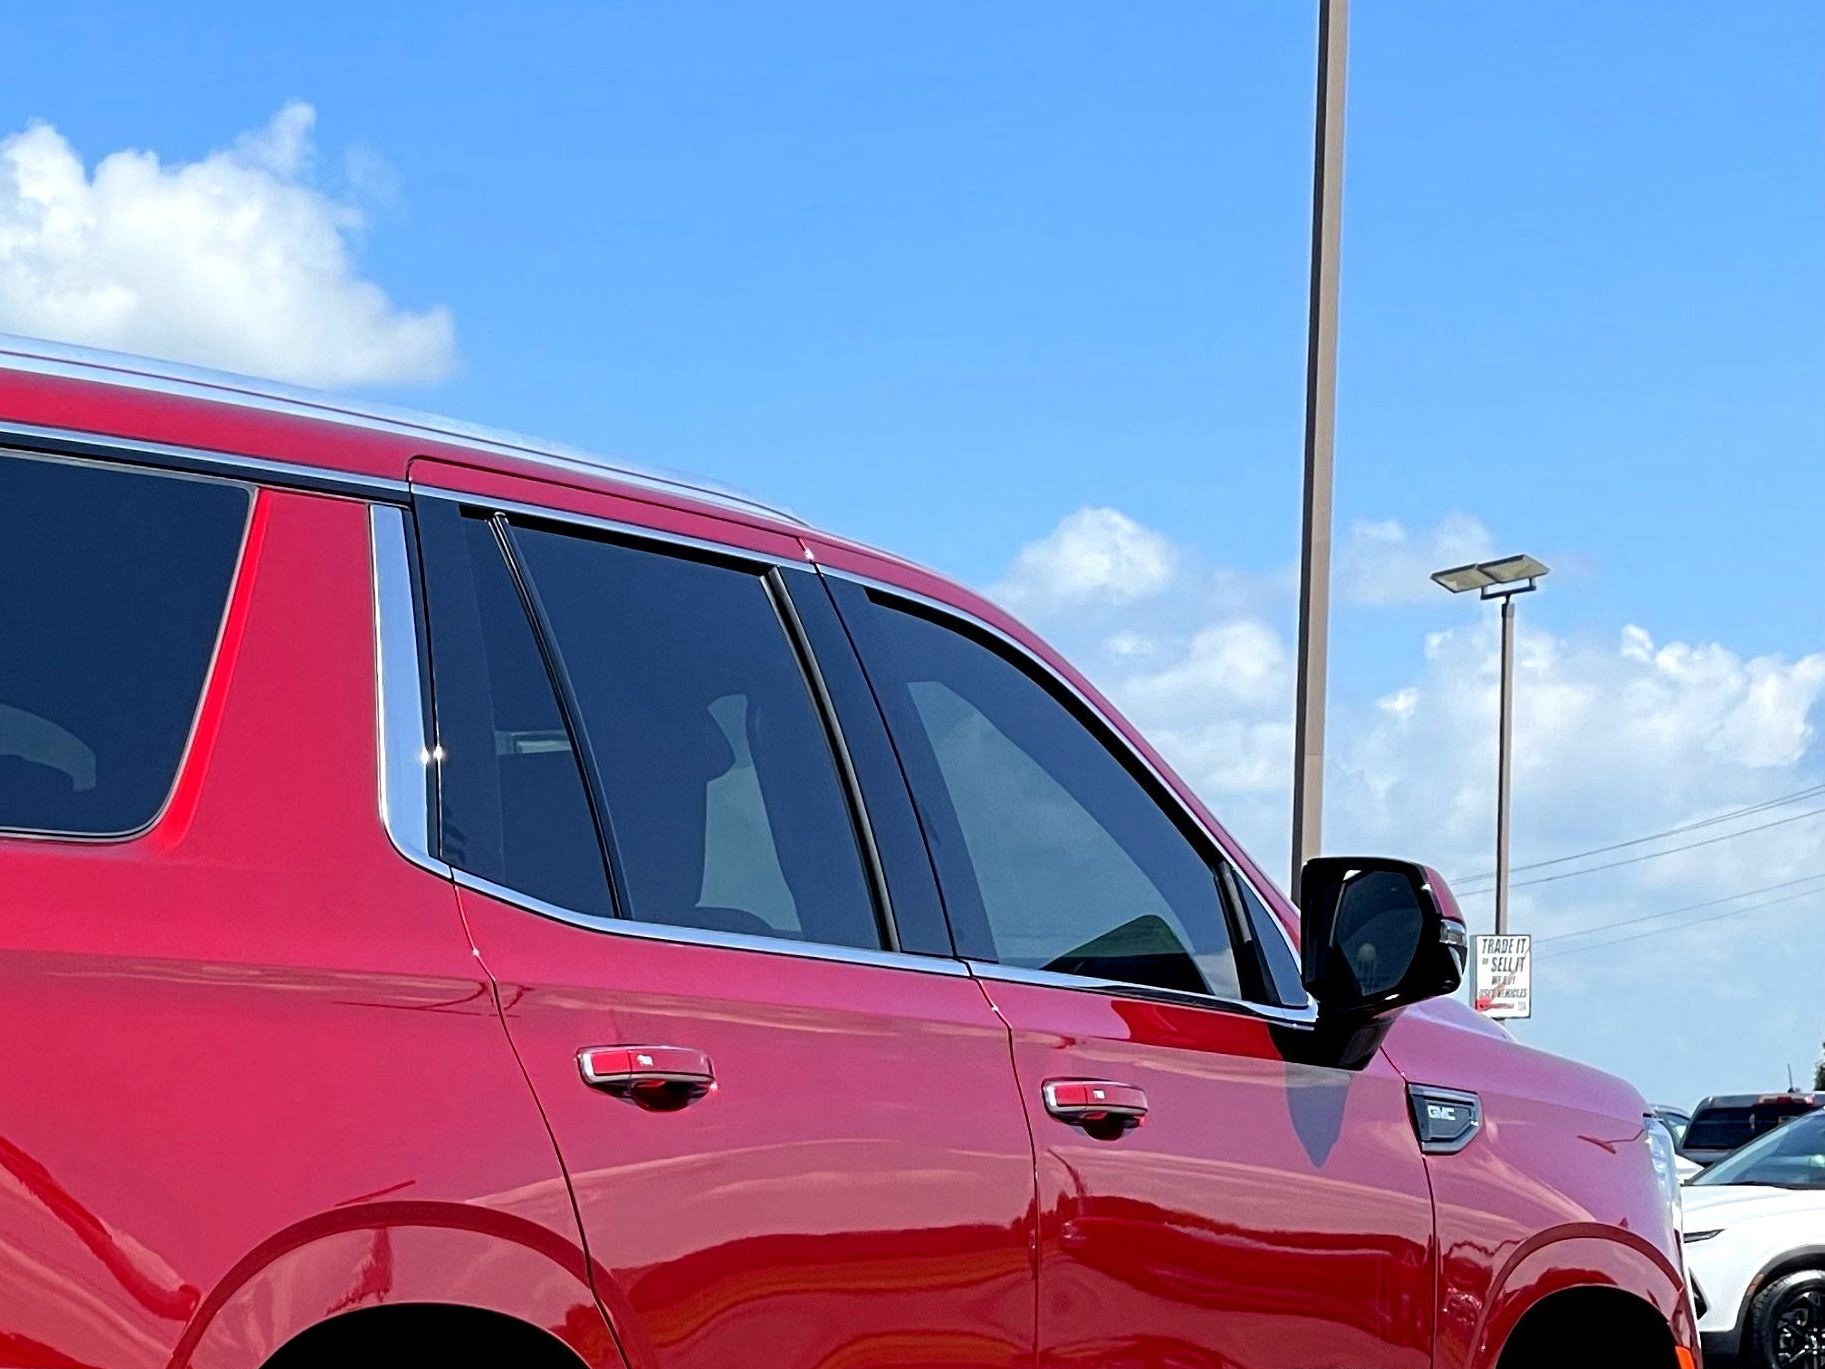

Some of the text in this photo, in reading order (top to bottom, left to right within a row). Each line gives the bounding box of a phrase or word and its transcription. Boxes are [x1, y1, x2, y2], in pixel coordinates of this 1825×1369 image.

[1482, 938, 1526, 953] TRADE IT
[1491, 957, 1512, 972] SELL
[1515, 956, 1525, 972] IT
[1427, 1105, 1456, 1120] GMC
